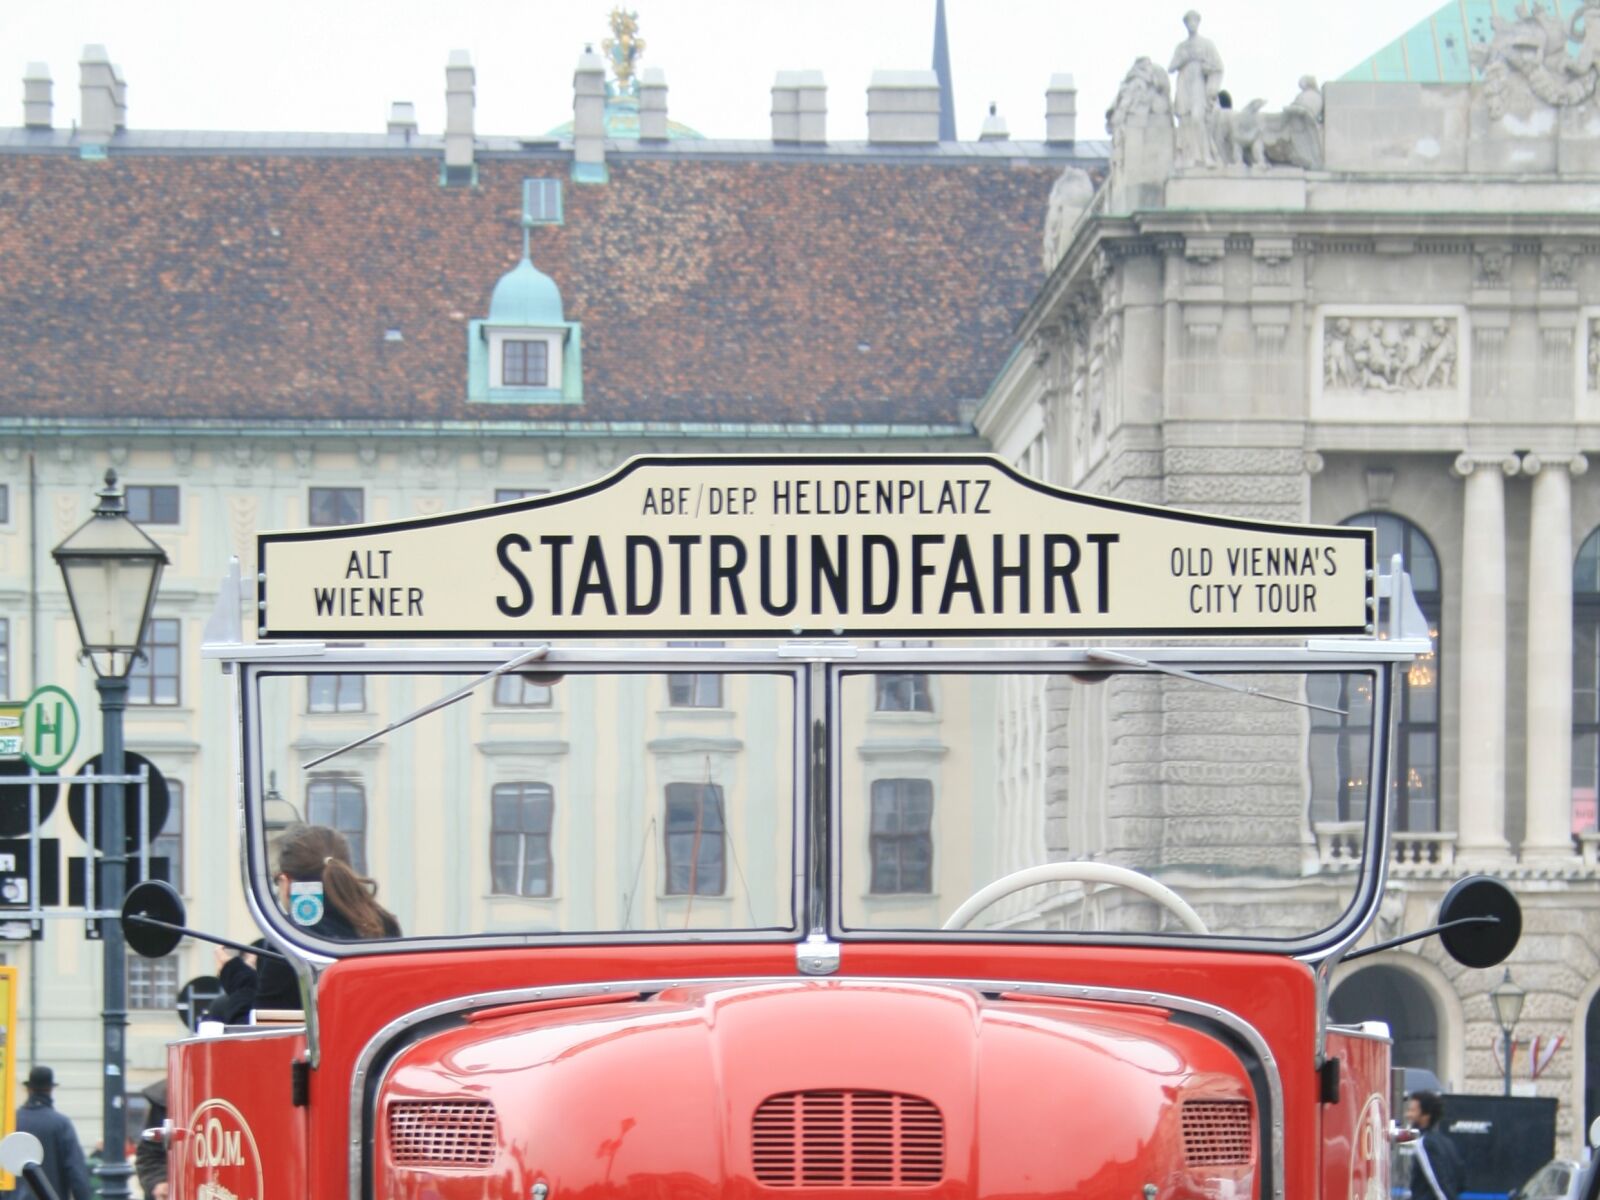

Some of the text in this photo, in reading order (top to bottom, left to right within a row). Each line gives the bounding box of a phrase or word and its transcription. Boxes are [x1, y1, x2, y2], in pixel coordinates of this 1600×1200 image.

[774, 480, 991, 515] HELDENPLATZ
[345, 550, 392, 579] ALT
[496, 533, 1120, 618] STADTRUNDFAHRT
[1171, 546, 1337, 577] OLD VIENNA'S
[314, 587, 423, 617] WIENER
[1189, 583, 1317, 614] CITY TOUR
[35, 702, 63, 756] H
